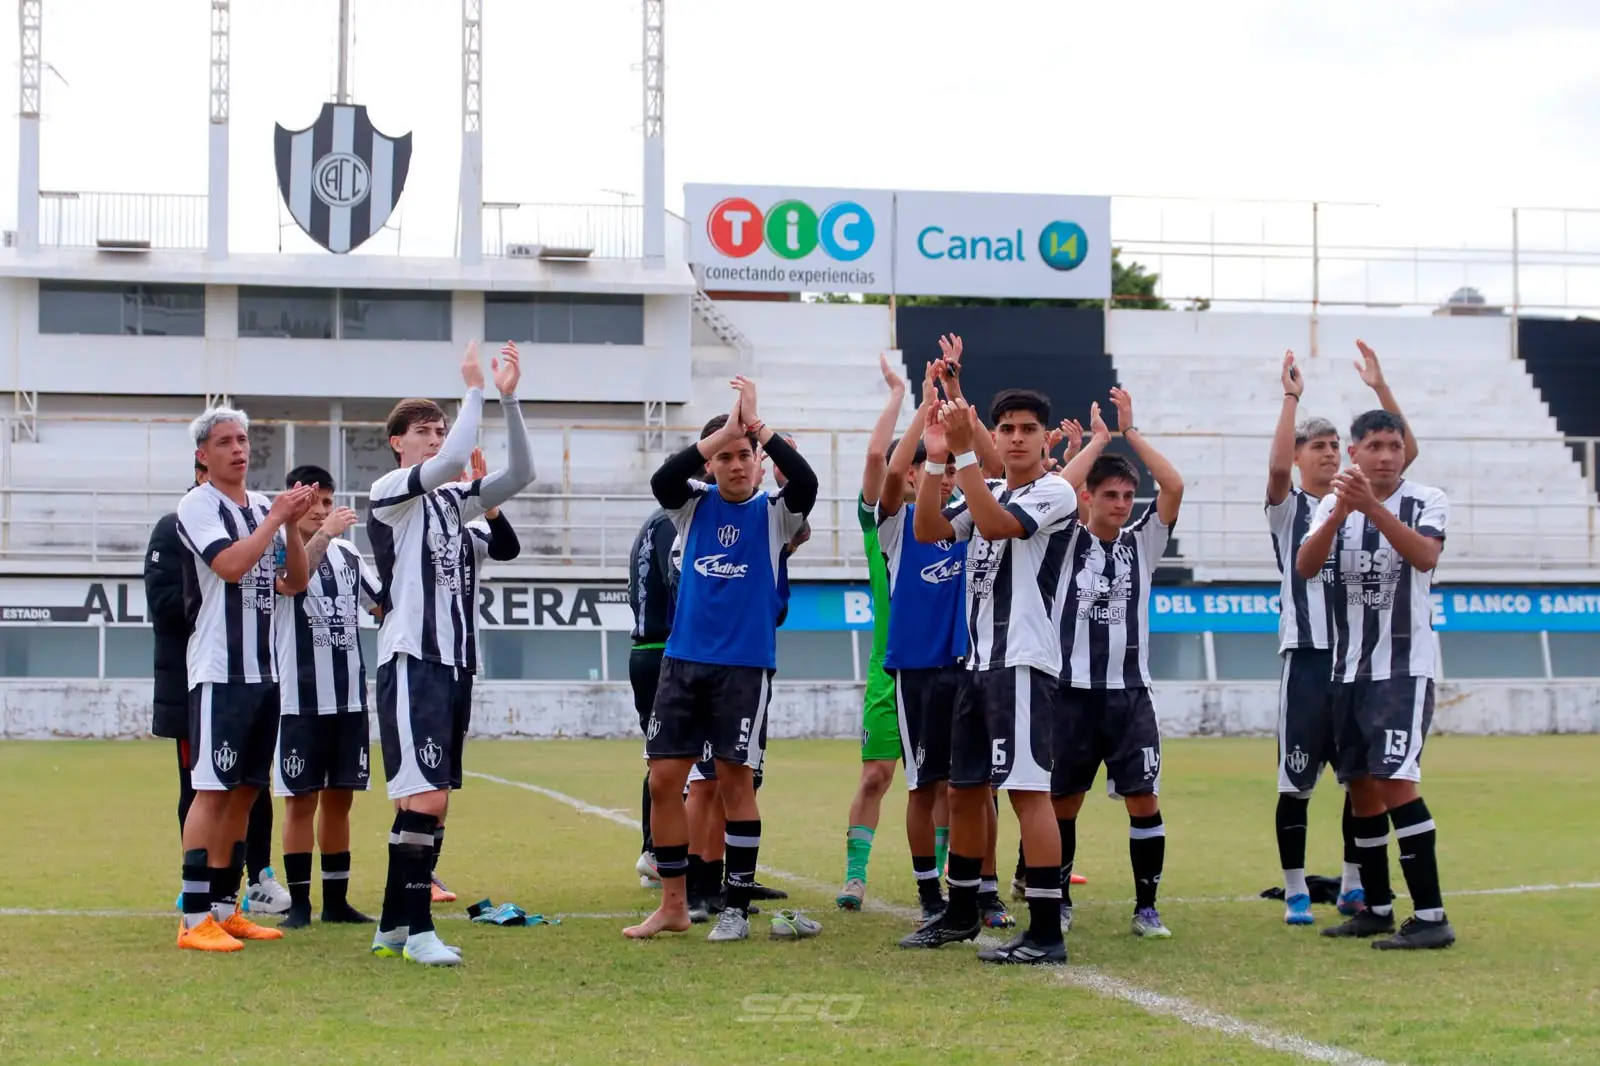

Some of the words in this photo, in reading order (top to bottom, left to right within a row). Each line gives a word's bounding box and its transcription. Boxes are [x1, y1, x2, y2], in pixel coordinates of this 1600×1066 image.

[917, 226, 1026, 262] Canal
[1050, 231, 1078, 261] 14
[705, 265, 786, 282] conectando
[788, 266, 876, 286] experiencias
[2, 608, 51, 619] ESTADIO
[1155, 594, 1197, 614] DEL
[1452, 594, 1532, 613] BANCO
[991, 738, 1007, 766] 6
[1383, 729, 1408, 757] 13
[359, 746, 368, 771] 4
[1140, 746, 1160, 773] 14
